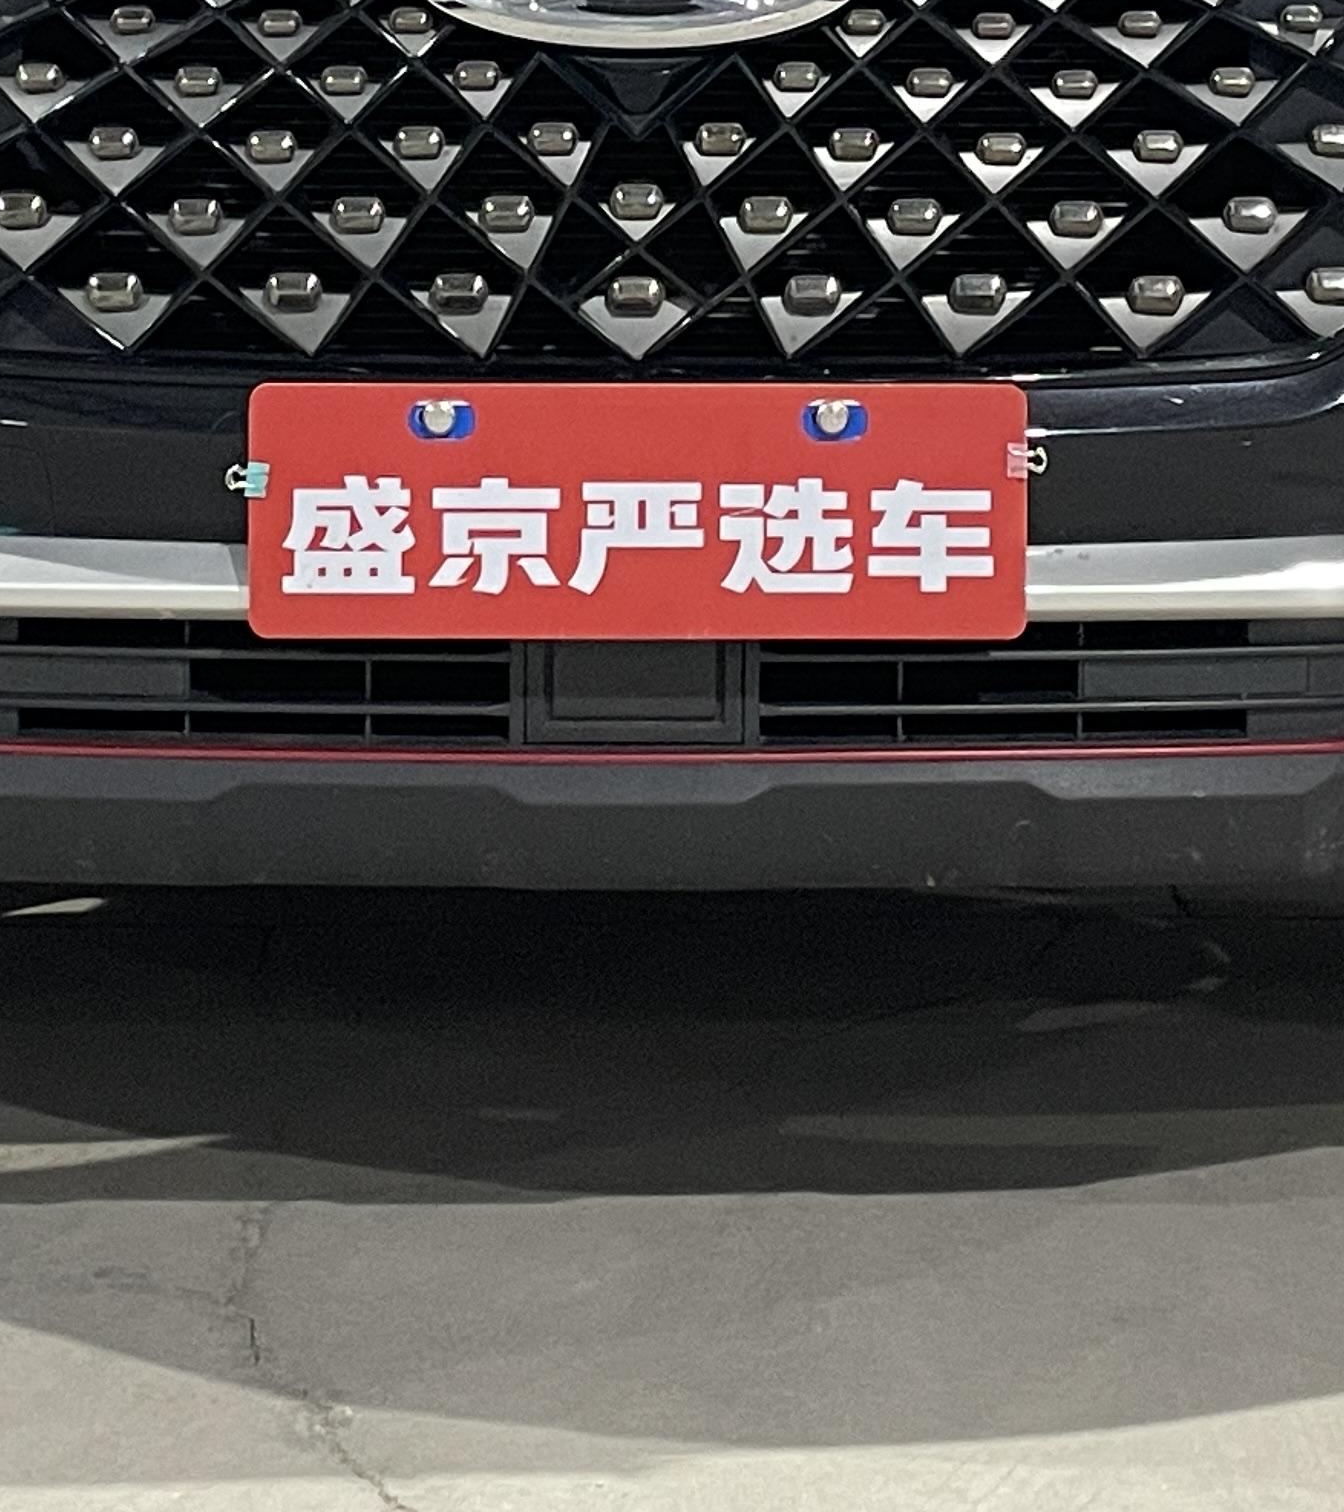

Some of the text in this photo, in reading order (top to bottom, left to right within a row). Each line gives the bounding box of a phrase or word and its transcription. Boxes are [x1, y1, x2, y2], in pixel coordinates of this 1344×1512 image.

[282, 476, 995, 595] 盛京严选车
